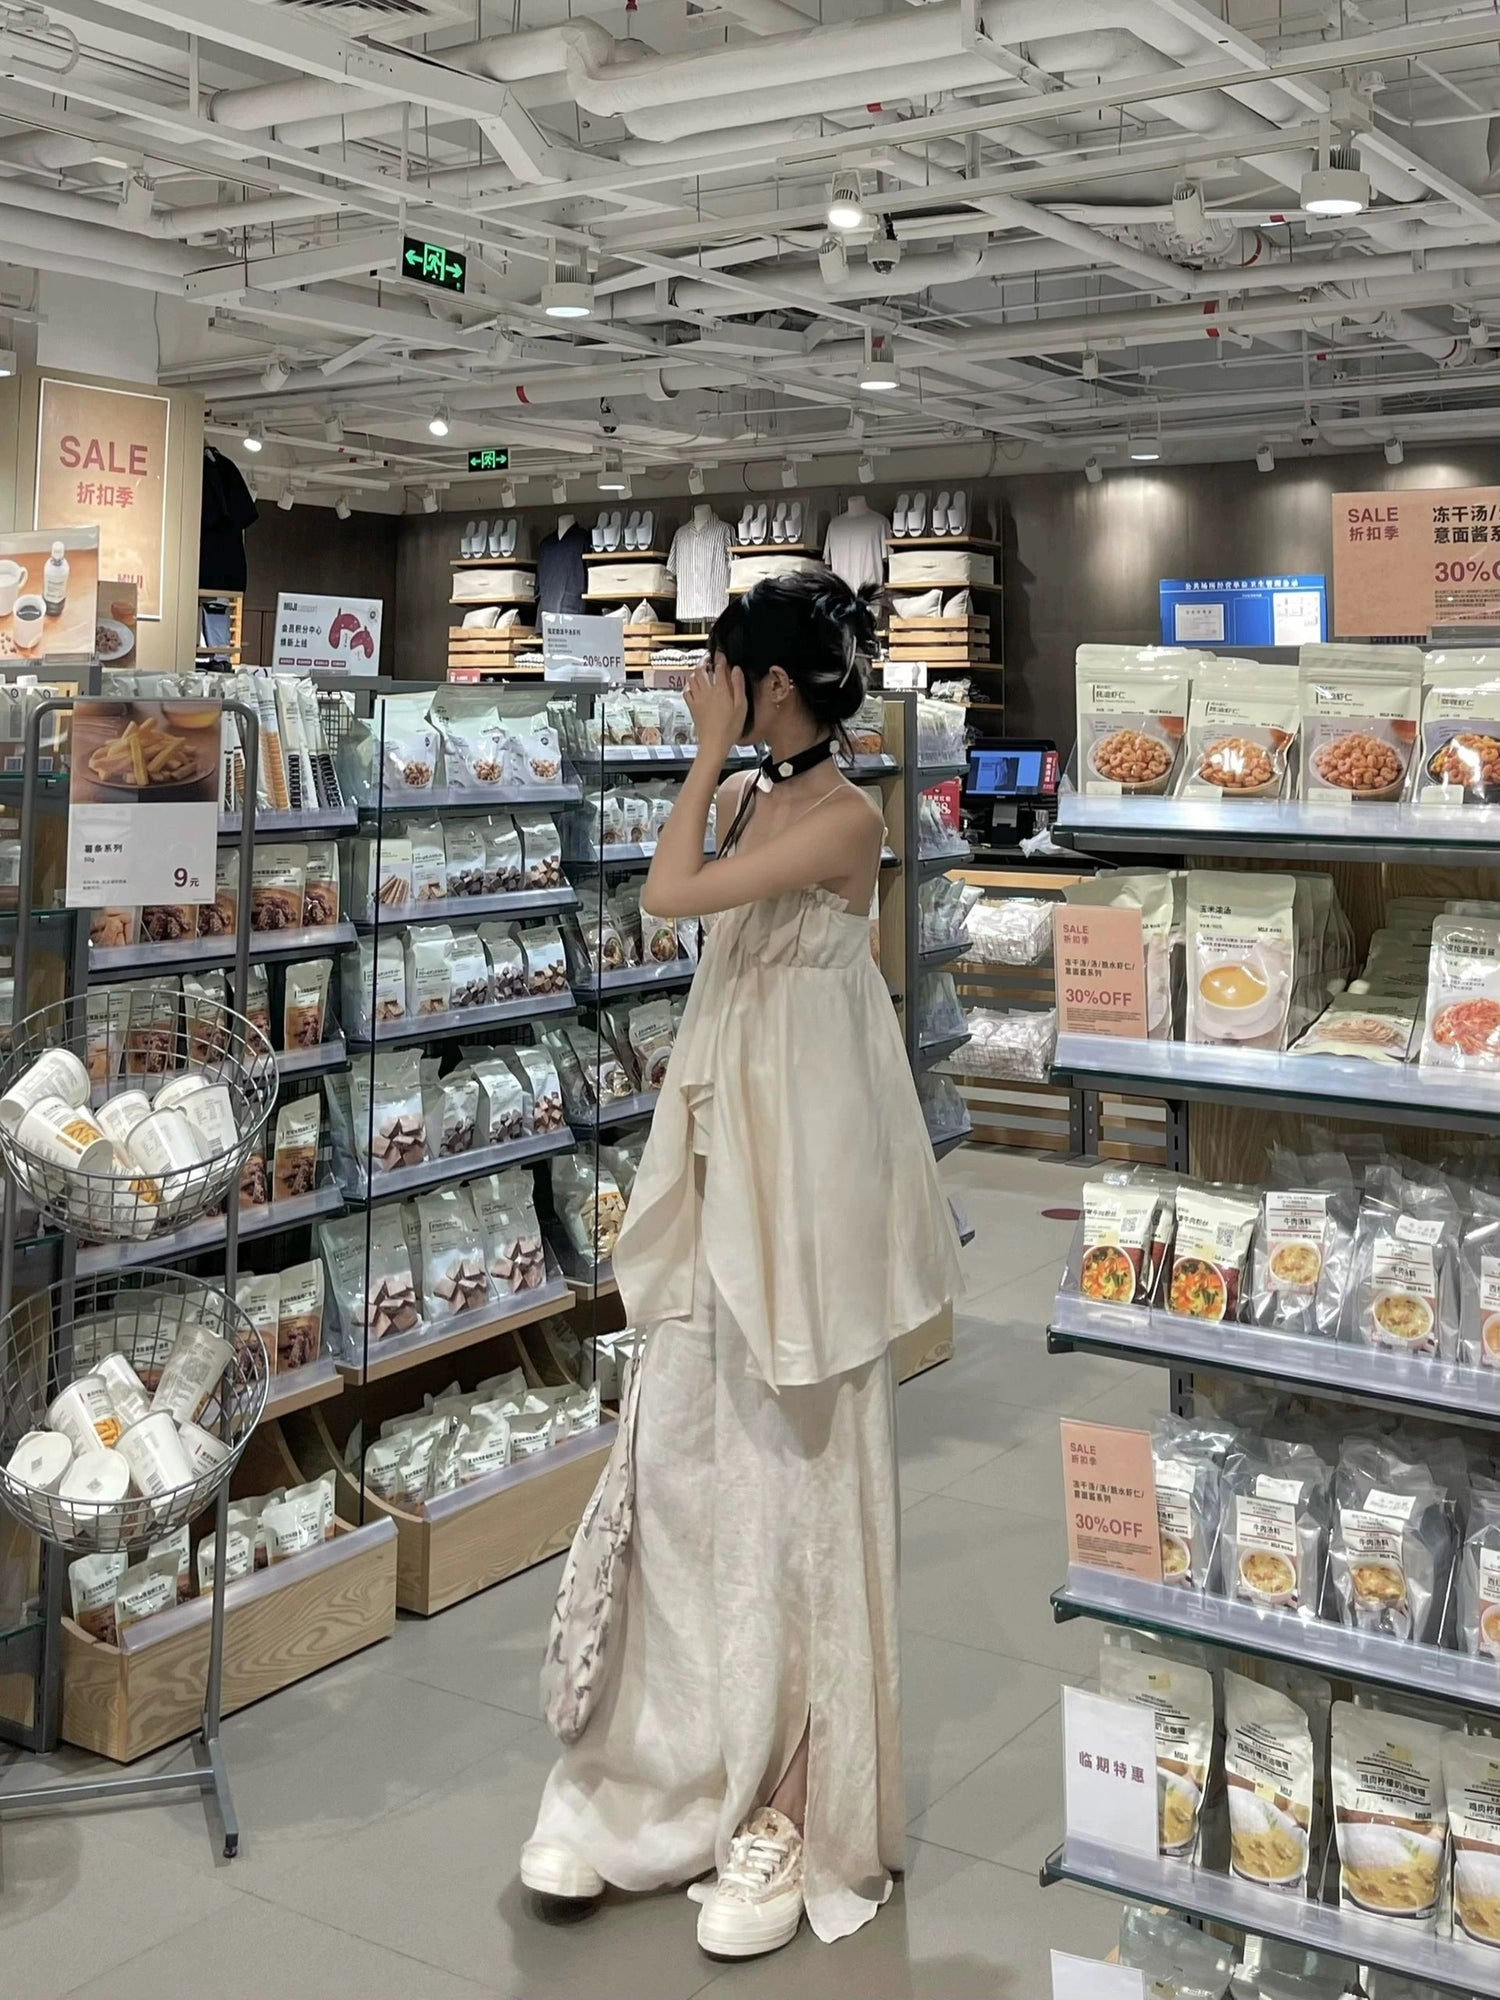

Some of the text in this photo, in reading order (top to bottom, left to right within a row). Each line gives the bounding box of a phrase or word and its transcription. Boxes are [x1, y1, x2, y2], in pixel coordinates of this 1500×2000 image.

[60, 435, 148, 476] SALE
[77, 481, 134, 508] 折扣季
[1348, 507, 1399, 523] SALE
[1433, 505, 1500, 523] 冻干汤/
[1349, 526, 1399, 542] 折扣季
[583, 655, 621, 668] 20%OFF
[668, 675, 687, 688] SAL
[174, 867, 199, 887] 9元
[1063, 924, 1088, 934] SALE
[1063, 935, 1089, 944] 折扣季
[1065, 988, 1131, 1007] 30%OFF
[1070, 1443, 1096, 1455] SALE
[1071, 1454, 1097, 1466] 折扣季
[1075, 1513, 1143, 1538] 30%OFF
[1079, 1750, 1145, 1784] 临期特惠
[1361, 1774, 1426, 1798] 鸡肉柠檬奶油咖喱
